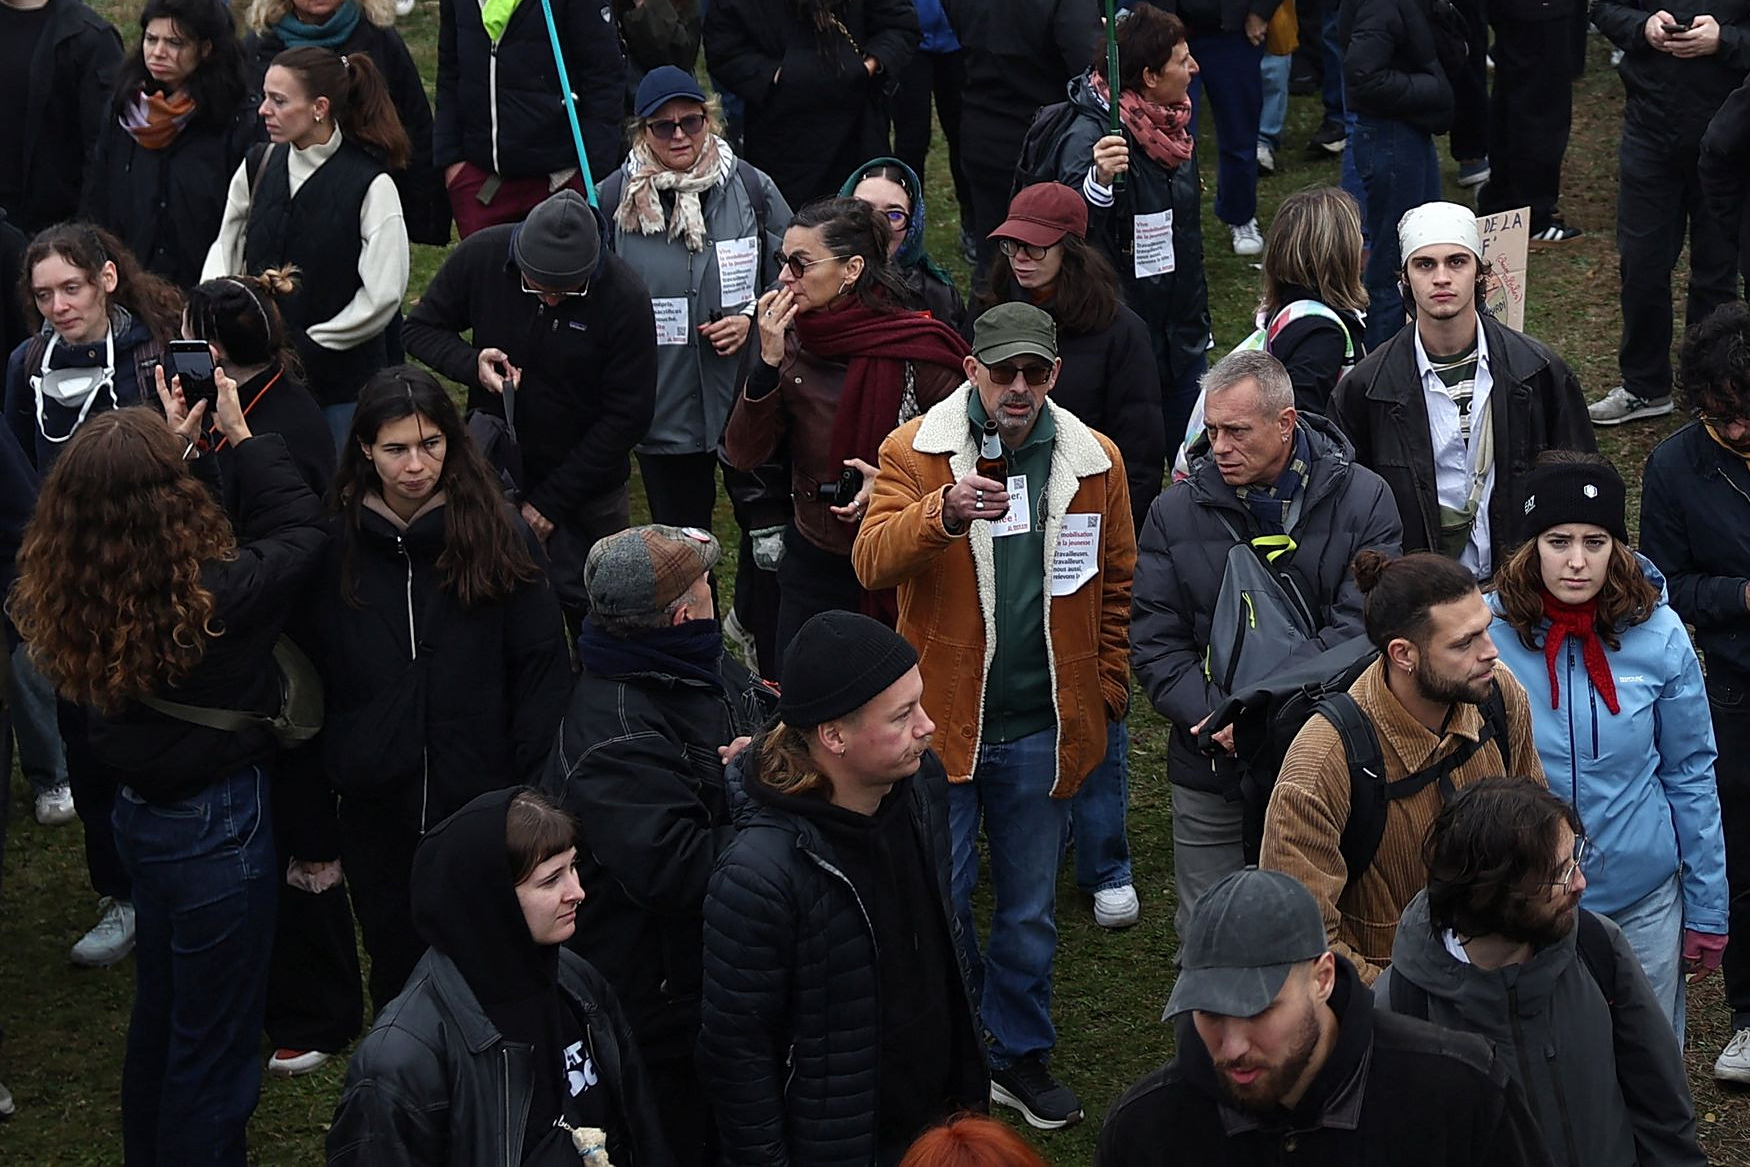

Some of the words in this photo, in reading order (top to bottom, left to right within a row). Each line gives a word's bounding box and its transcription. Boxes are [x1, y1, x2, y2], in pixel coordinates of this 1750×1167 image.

[1484, 216, 1498, 234] DE
[1501, 213, 1522, 231] LA
[1054, 550, 1088, 558] Travailleuses,
